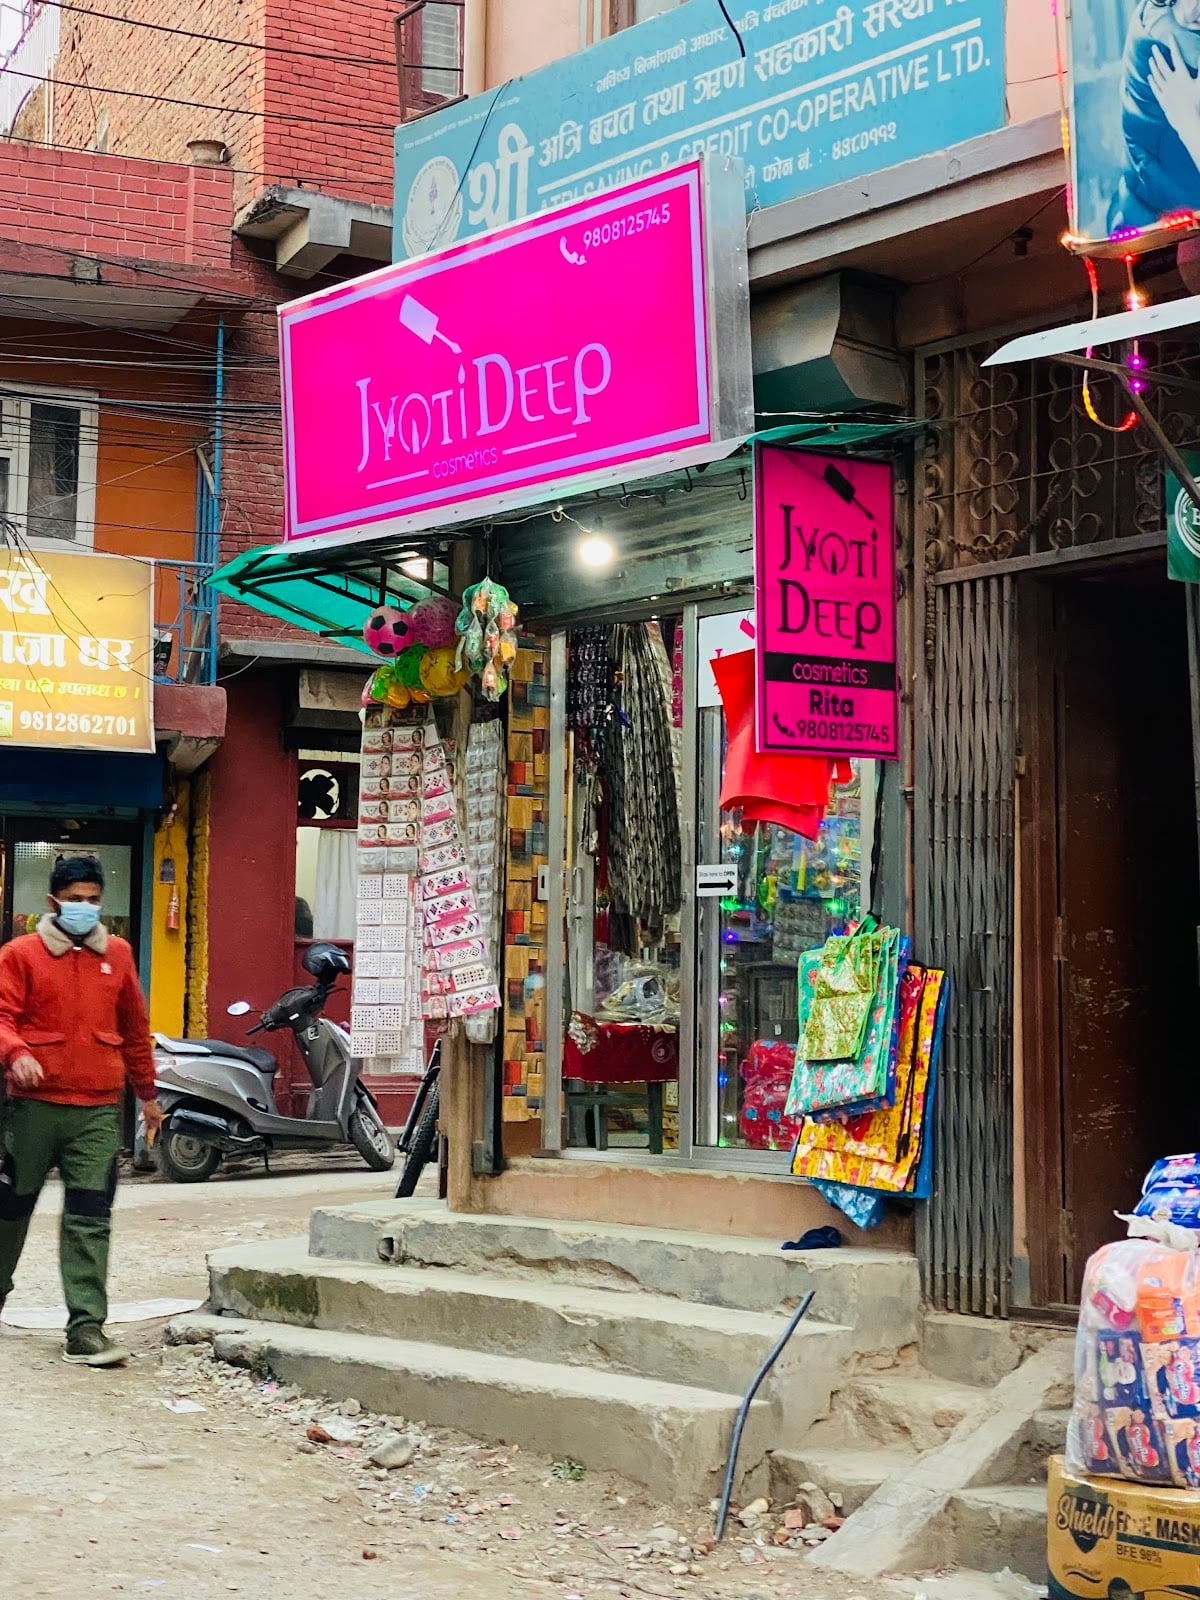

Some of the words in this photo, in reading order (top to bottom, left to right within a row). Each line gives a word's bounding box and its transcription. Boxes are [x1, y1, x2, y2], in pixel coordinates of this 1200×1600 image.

[757, 54, 929, 146] CO-OPERATIVE
[937, 36, 991, 82] LTD.
[468, 123, 535, 231] श्री
[538, 120, 584, 167] अत्रि
[588, 101, 637, 145] बचत
[642, 81, 687, 125] तथा
[693, 57, 747, 104] ऋण
[754, 5, 854, 82] सहकारी
[763, 156, 793, 182] फोन
[832, 121, 897, 160] ४४८०११२
[582, 203, 672, 250] 9808125745
[432, 446, 498, 479] cosmetics
[79, 636, 134, 672] घर
[792, 662, 868, 686] cosmetics
[809, 689, 855, 718] Rita
[20, 710, 137, 737] 9812862701
[796, 720, 890, 744] 9808125745
[1056, 1493, 1114, 1540] Shield
[1116, 1544, 1138, 1559] BFE
